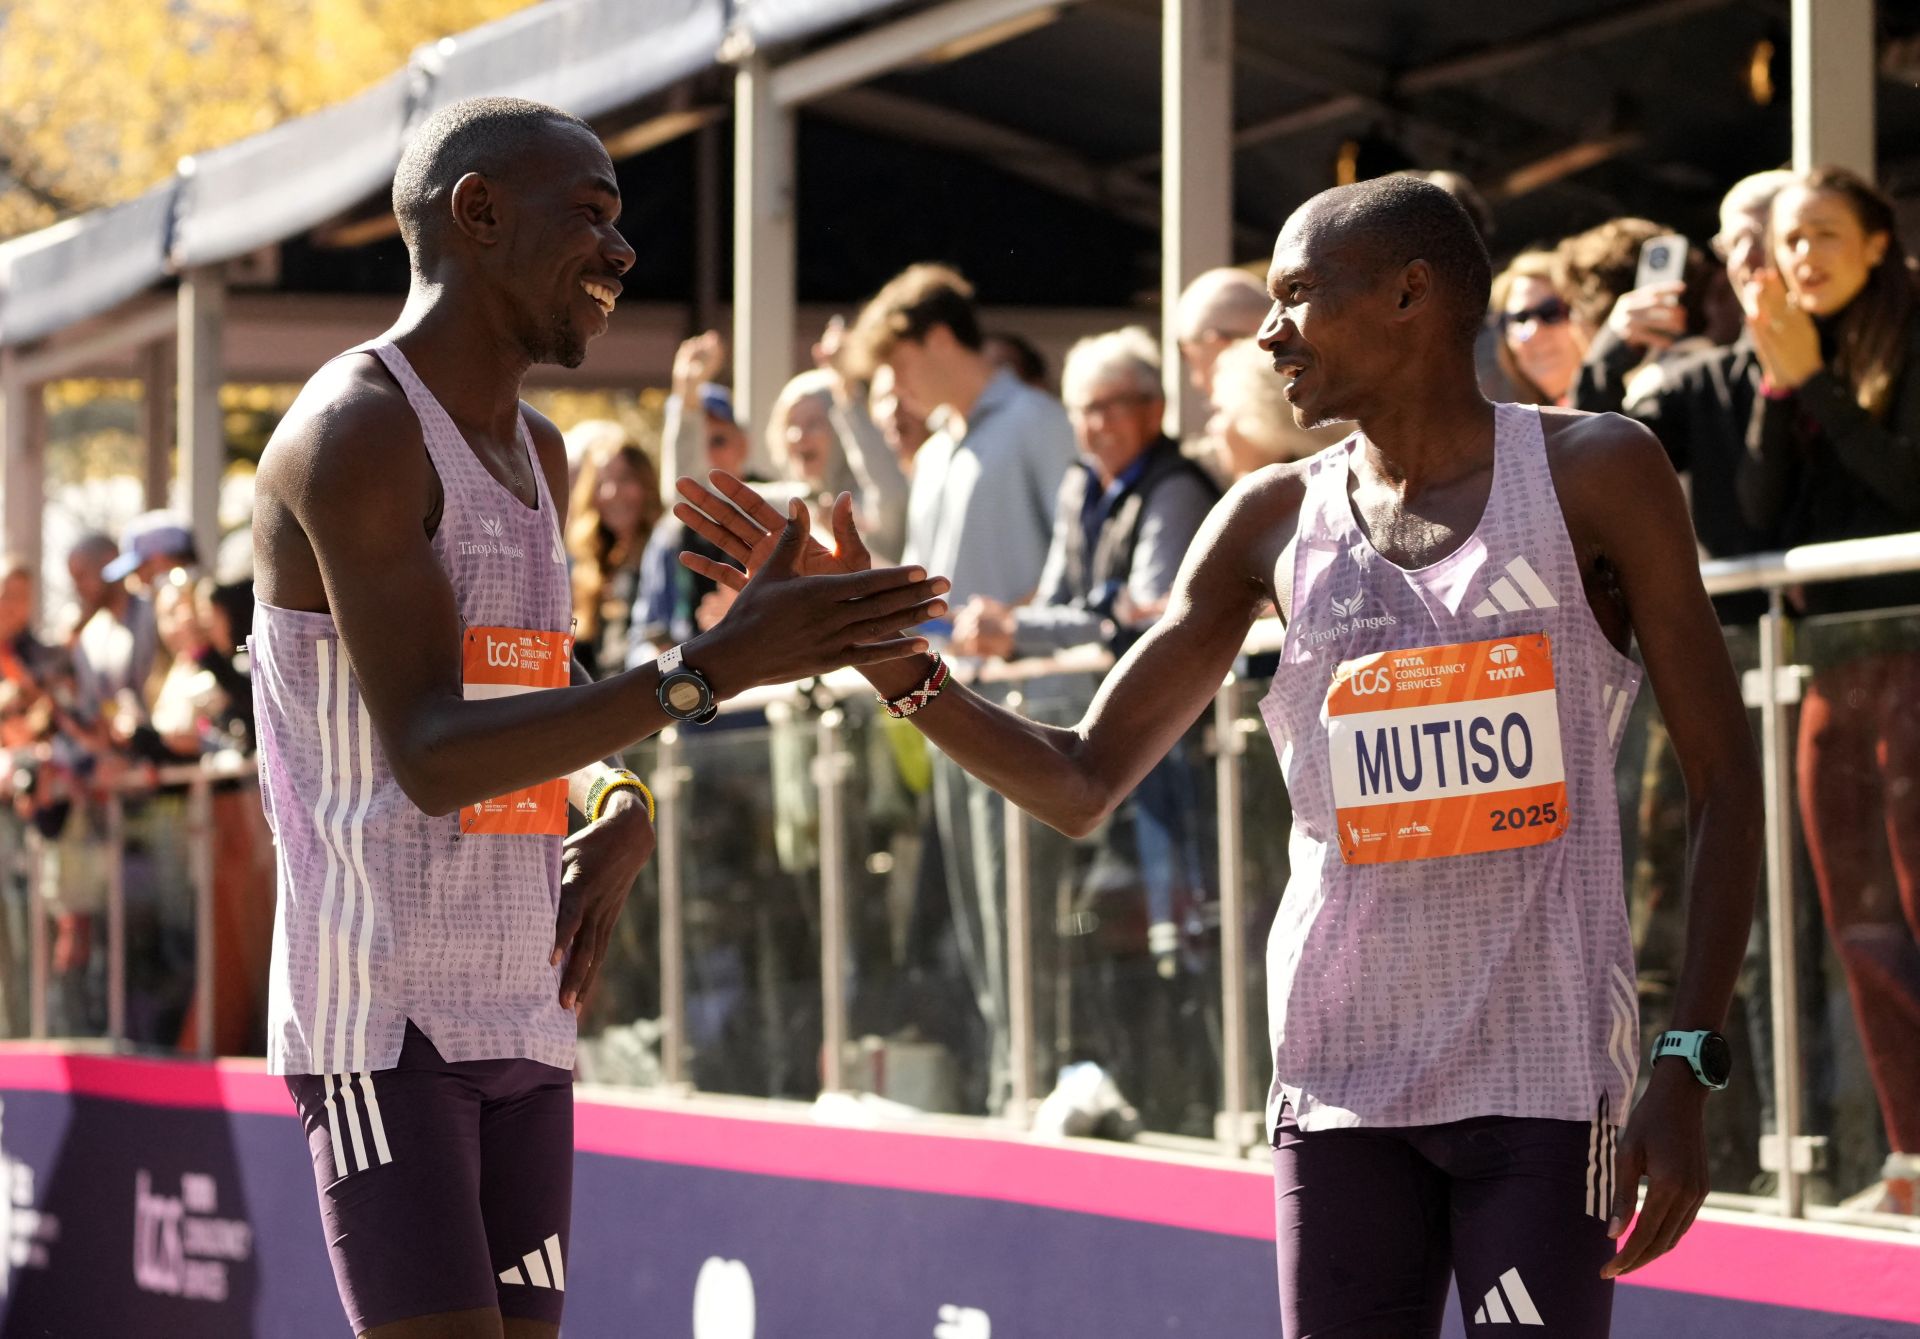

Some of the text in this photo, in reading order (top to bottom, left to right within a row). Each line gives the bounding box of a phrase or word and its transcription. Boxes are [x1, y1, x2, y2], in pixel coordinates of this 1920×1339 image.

[459, 541, 498, 557] Tirop's
[1352, 611, 1398, 631] Angels
[486, 635, 519, 668] tcs
[1393, 656, 1425, 668] TATA
[1395, 663, 1467, 680] CONSULTANCY
[1486, 665, 1526, 681] TATA
[1396, 677, 1443, 692] SERVICES
[1355, 711, 1534, 797] MUTISO
[1489, 802, 1558, 832] 2025
